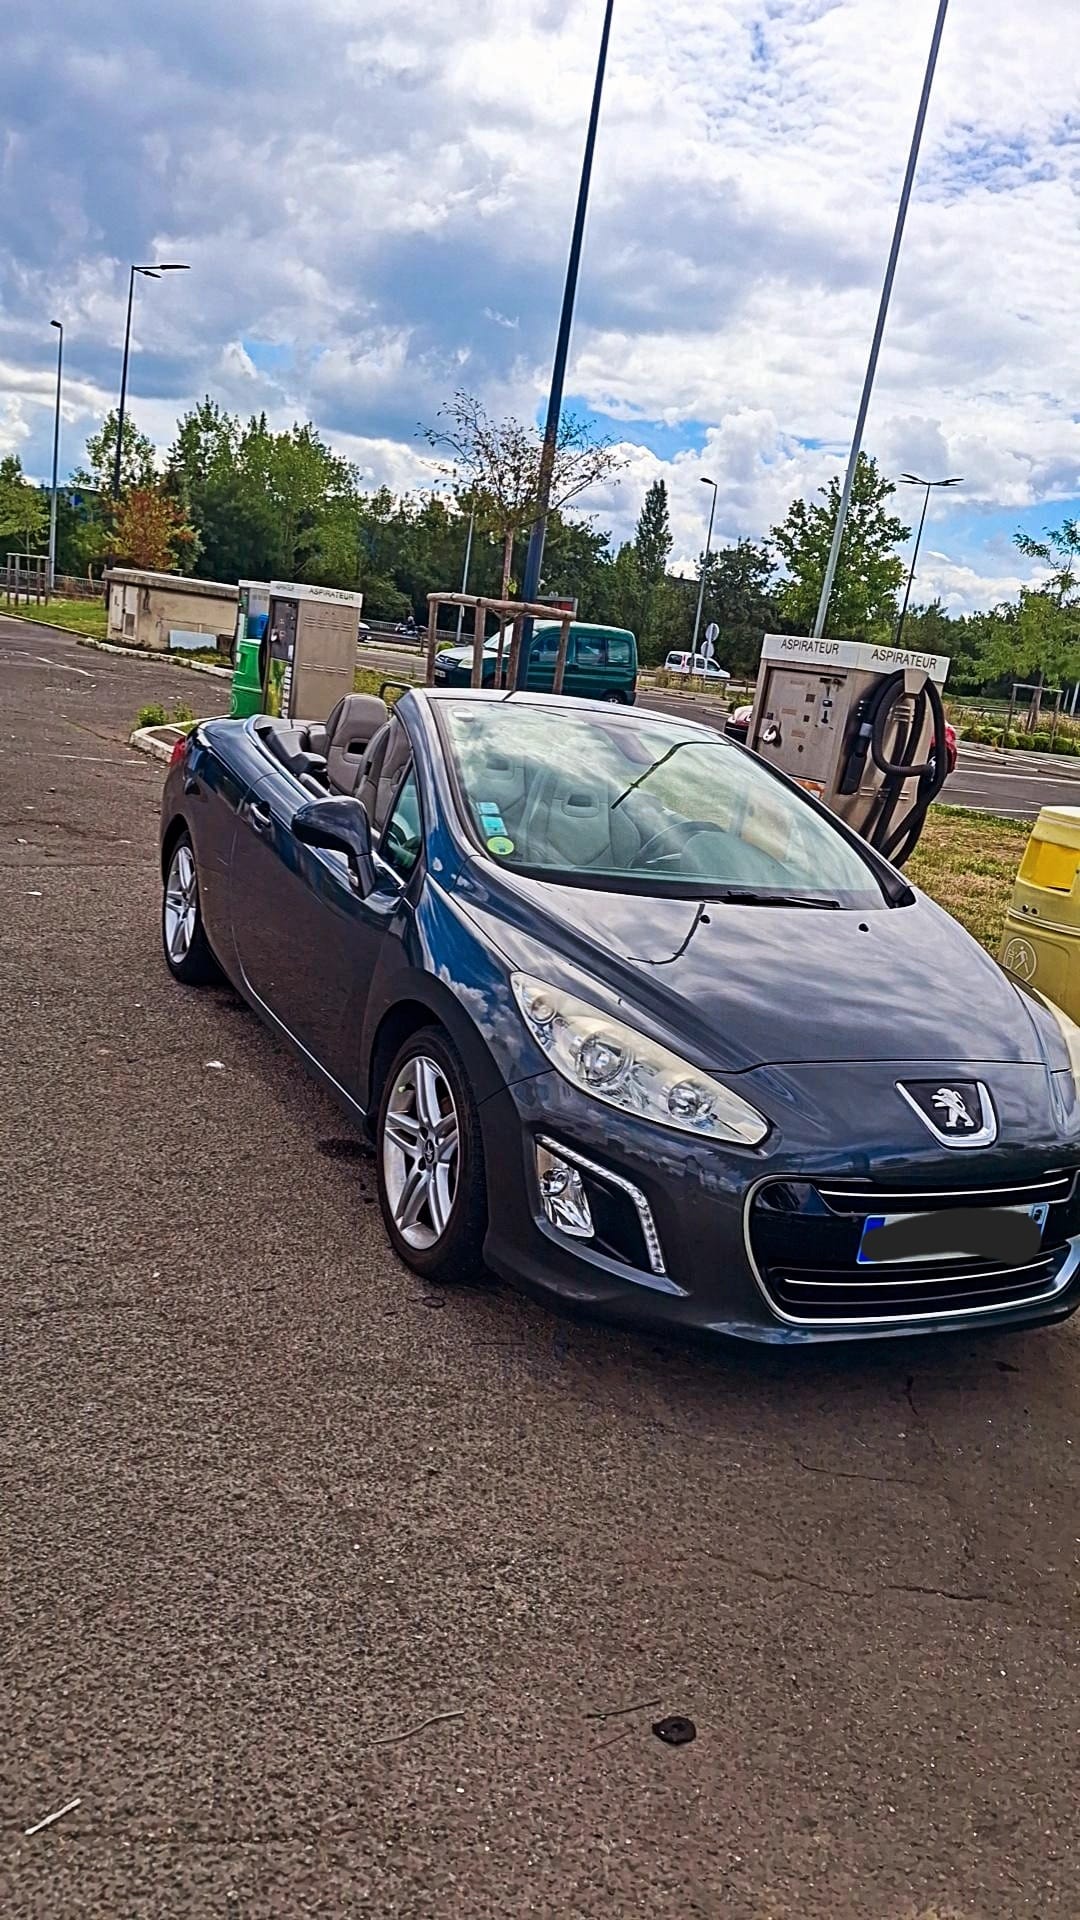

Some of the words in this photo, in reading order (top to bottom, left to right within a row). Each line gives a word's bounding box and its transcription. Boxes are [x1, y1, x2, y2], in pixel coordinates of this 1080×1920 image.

[309, 588, 354, 601] ASPIRATEUR
[781, 639, 839, 654] ASPIRATEUR
[871, 649, 937, 669] ASPIRATEUR
